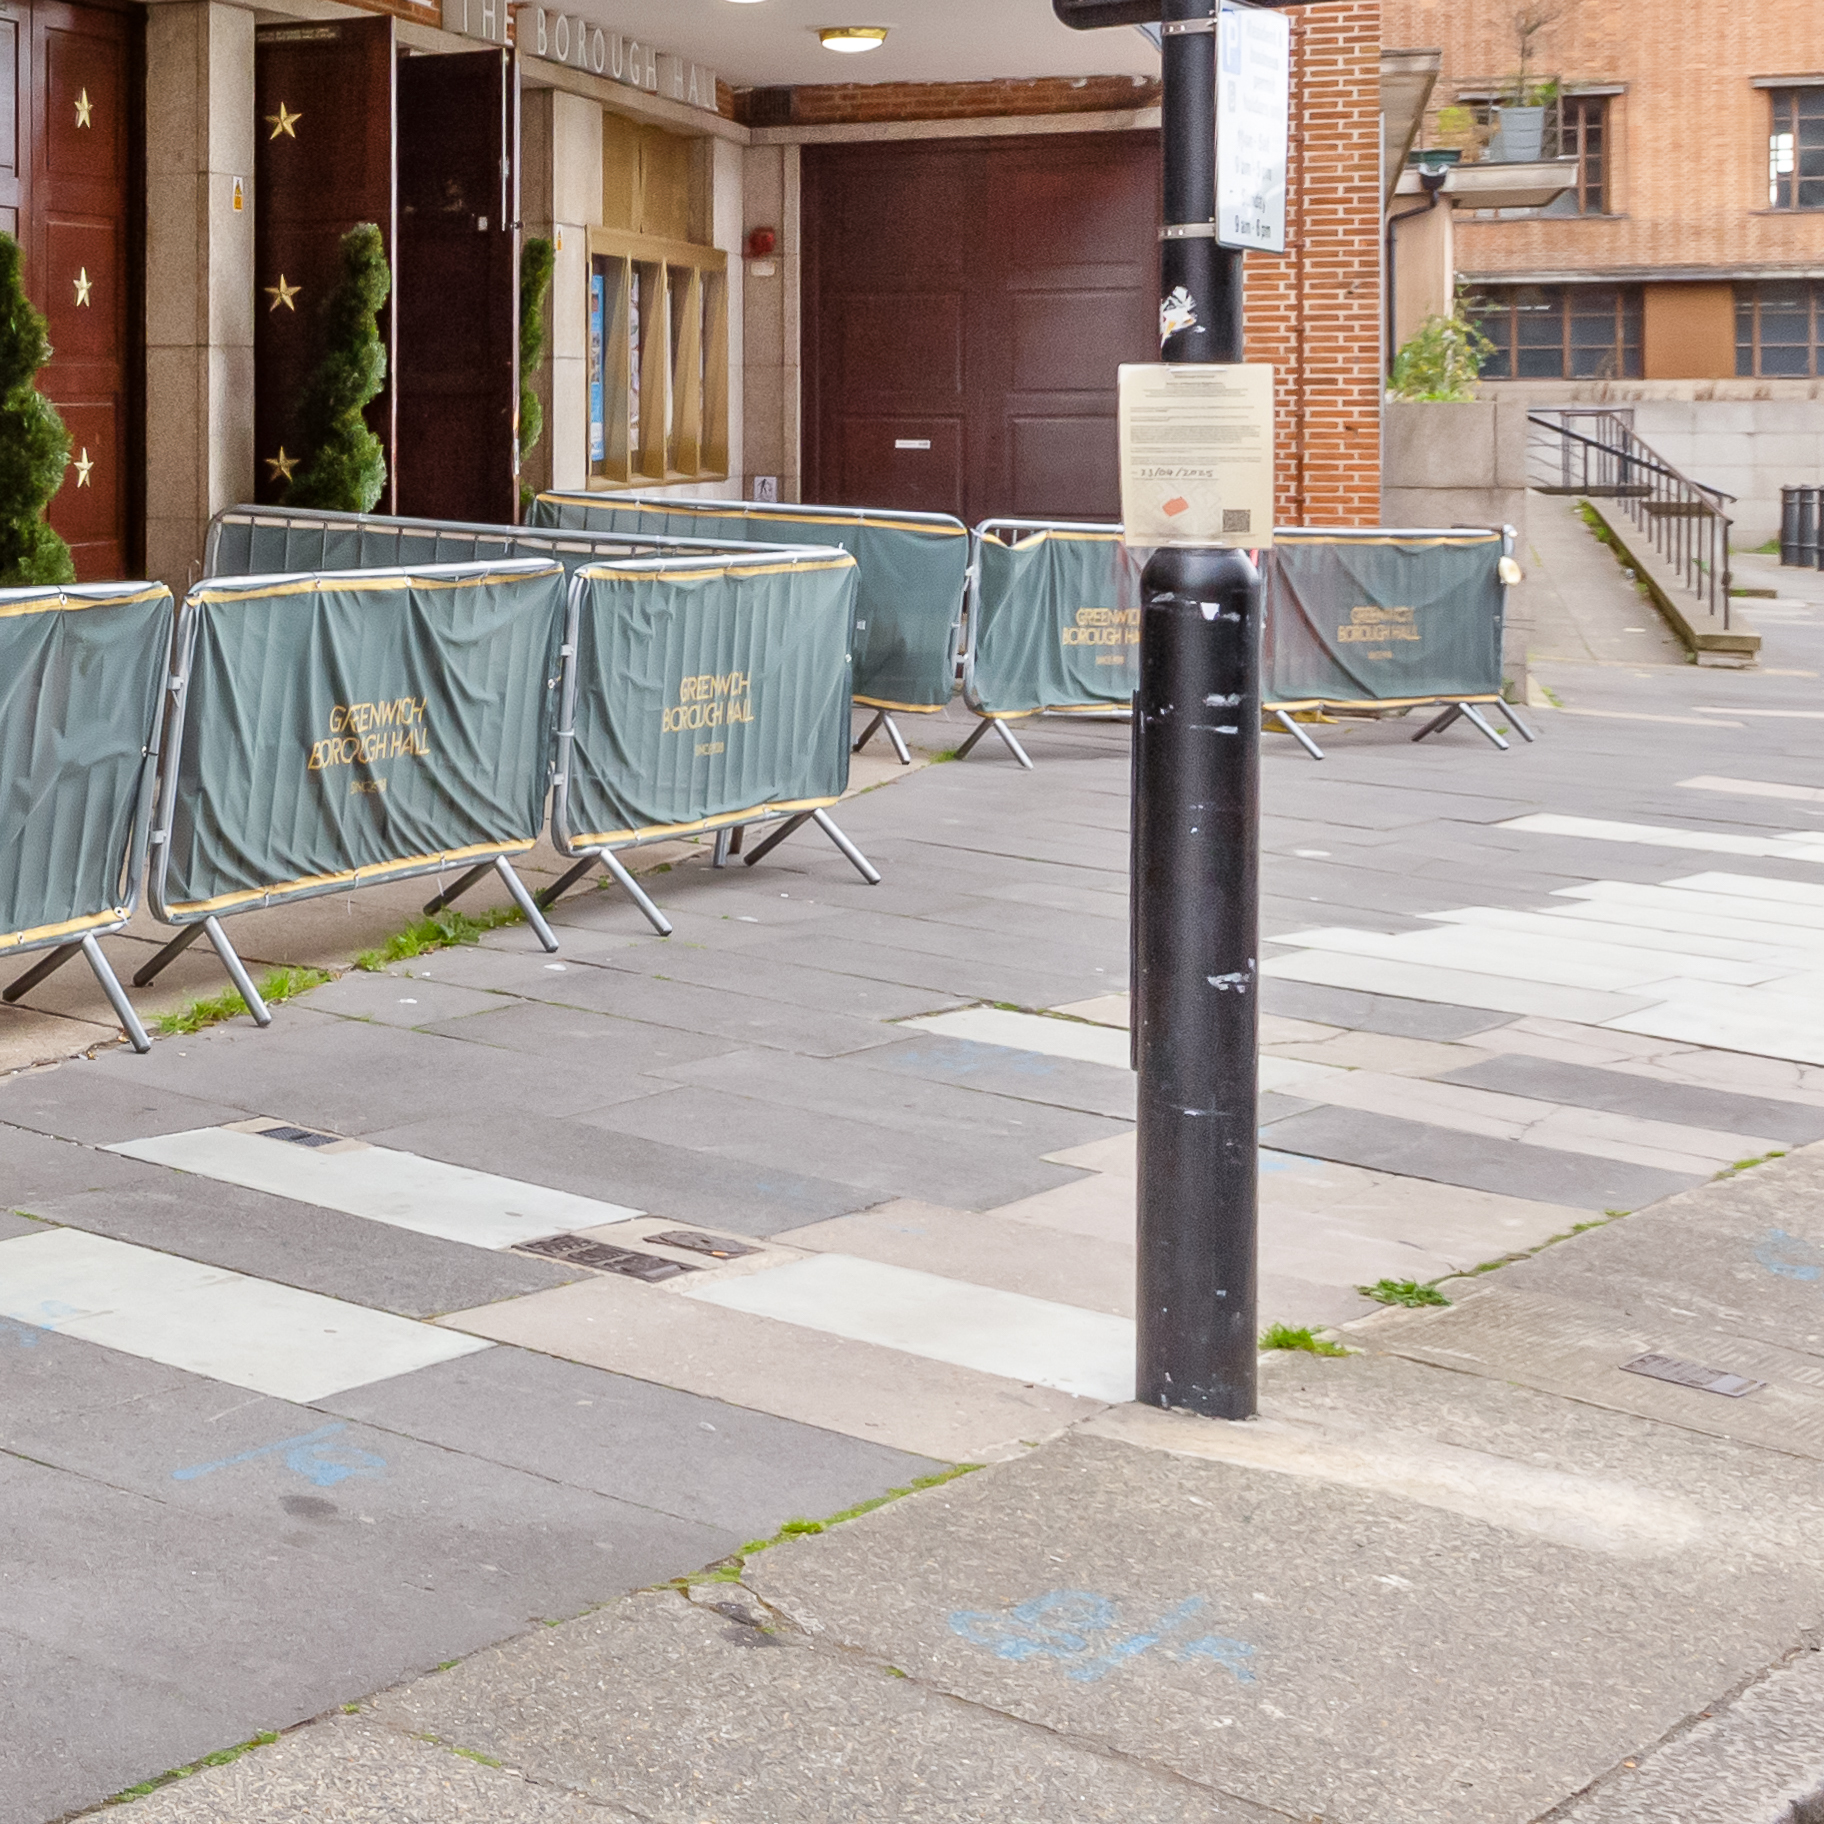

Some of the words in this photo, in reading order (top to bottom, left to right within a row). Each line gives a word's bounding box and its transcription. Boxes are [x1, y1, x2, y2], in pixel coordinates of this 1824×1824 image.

[534, 6, 657, 91] BOROUGH
[671, 55, 719, 113] HALL
[662, 702, 723, 733] BOROUGH
[308, 732, 388, 770] BOROUGH
[390, 728, 430, 757] HALL
